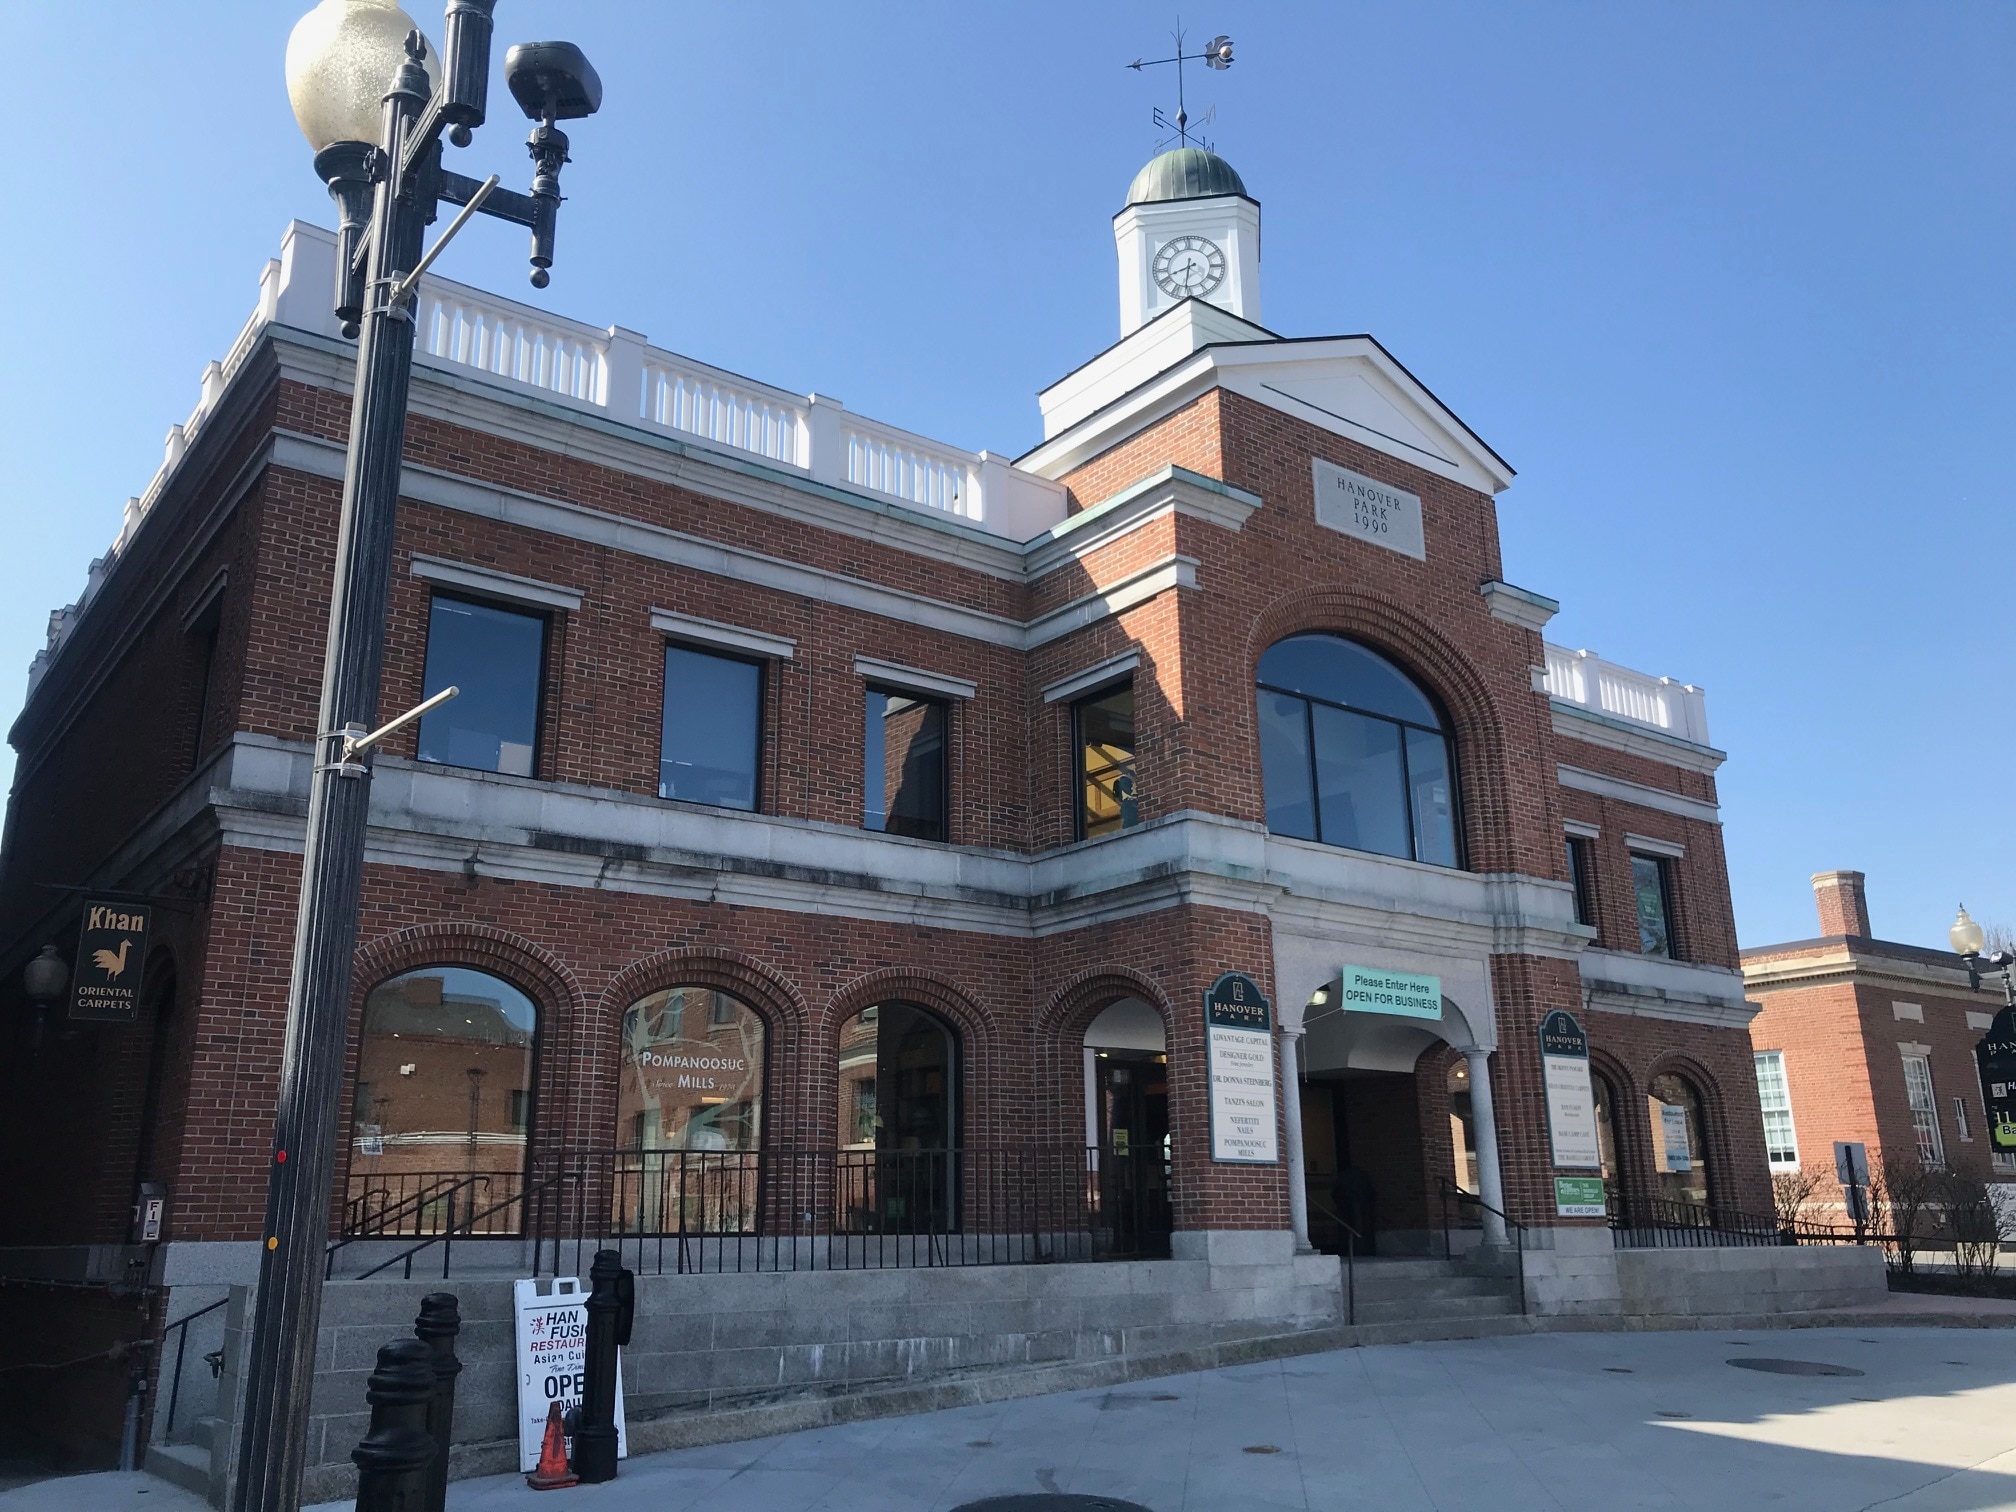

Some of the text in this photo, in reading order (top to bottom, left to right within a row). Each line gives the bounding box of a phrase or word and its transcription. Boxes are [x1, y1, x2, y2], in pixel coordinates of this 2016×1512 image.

[1337, 477, 1401, 511] HANOVER
[1354, 497, 1388, 521] PARK
[1354, 512, 1388, 534] 1990
[88, 905, 144, 932] Khan
[78, 986, 134, 998] ORIENTAL
[1354, 974, 1430, 994] Please Enter Here
[77, 998, 131, 1010] CARPETS
[1214, 1002, 1264, 1015] HANOVER
[1345, 990, 1438, 1010] OPEN FOR BUSINESS
[1215, 1012, 1263, 1023] PARK
[1545, 1034, 1583, 1045] HANOVER
[642, 1051, 745, 1071] POMPANOOSUC
[677, 1073, 715, 1089] MILLS
[146, 1202, 160, 1238] FIE
[546, 1310, 578, 1326] HAN
[534, 1353, 564, 1364] Asian
